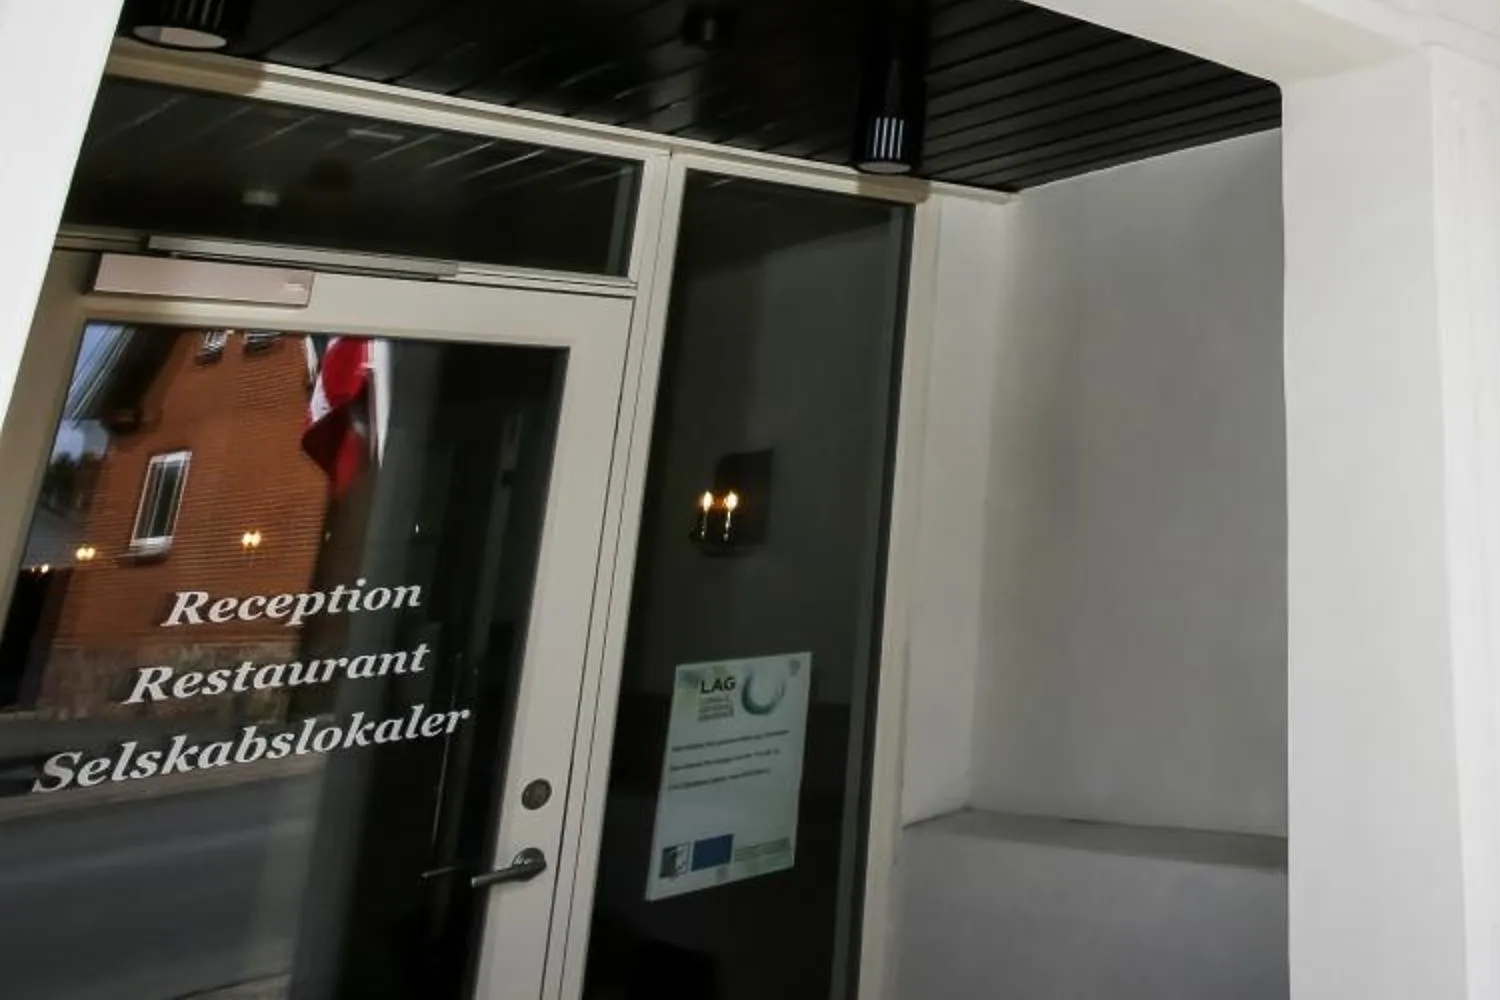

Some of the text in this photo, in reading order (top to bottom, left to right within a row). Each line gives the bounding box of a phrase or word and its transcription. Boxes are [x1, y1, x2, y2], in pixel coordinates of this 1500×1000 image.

[160, 578, 422, 628] Reception
[121, 642, 431, 706] Restaurant
[700, 676, 736, 694] LAG
[32, 703, 471, 794] Selskabslokaler
